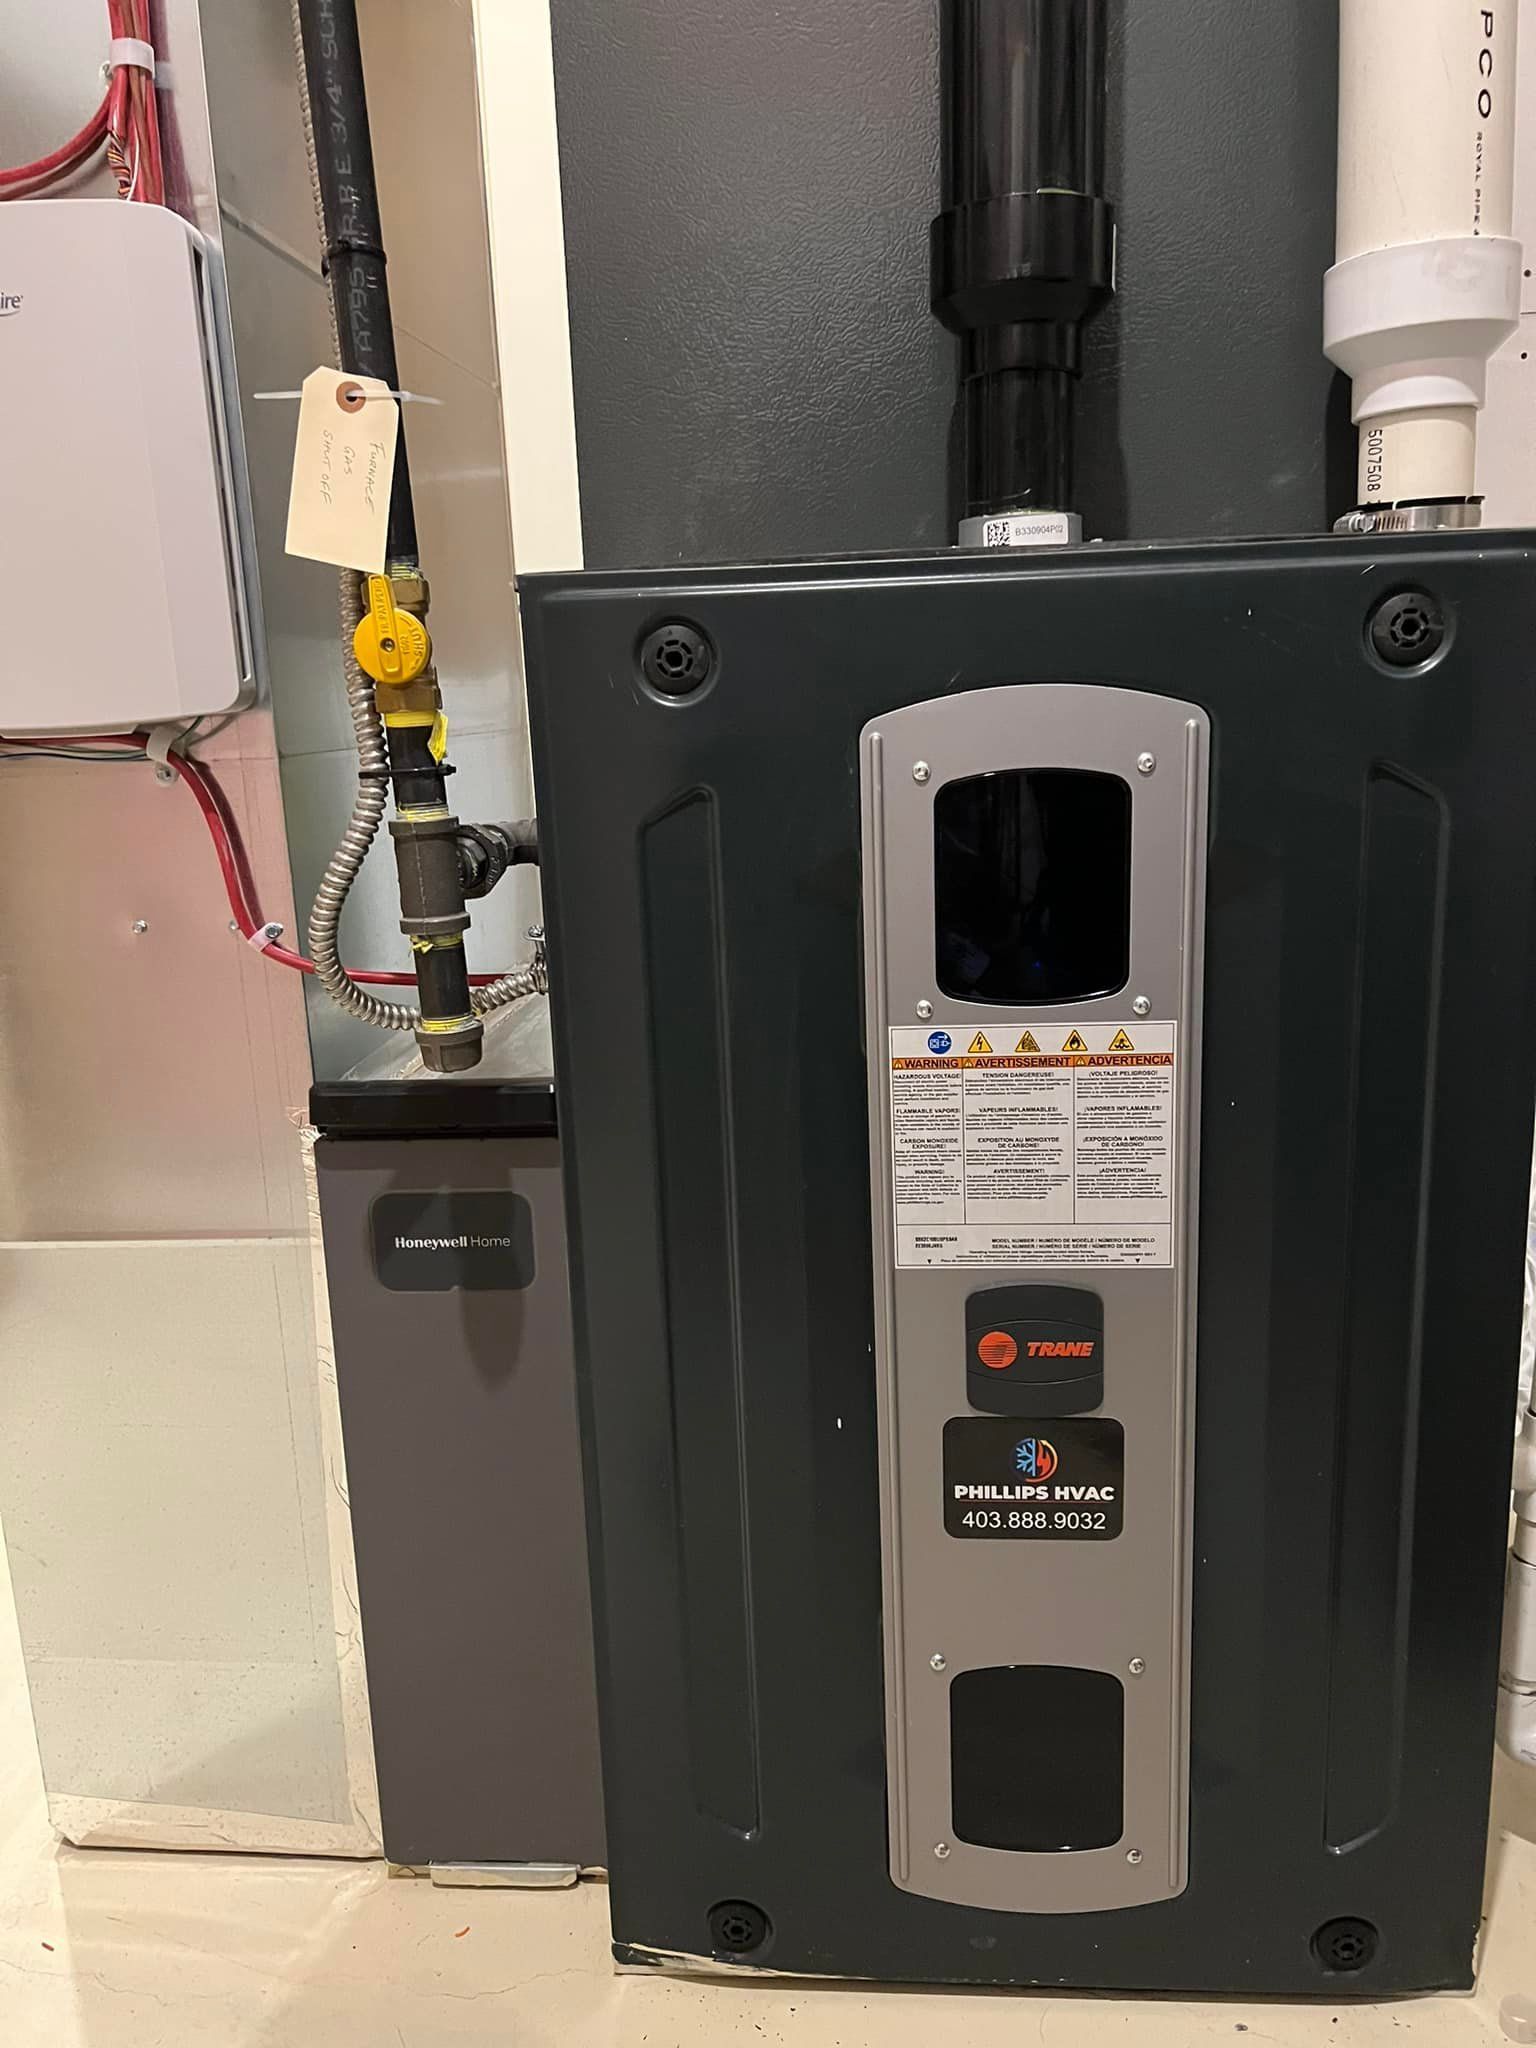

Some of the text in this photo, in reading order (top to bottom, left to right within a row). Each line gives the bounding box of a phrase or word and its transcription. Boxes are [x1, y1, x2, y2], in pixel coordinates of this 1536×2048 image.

[1367, 428, 1383, 492] 5007508
[904, 1058, 959, 1069] WARNING
[974, 1057, 1072, 1068] AVERTISSEMENT
[1087, 1055, 1172, 1066] ADVERTENCIA
[395, 1236, 511, 1250] Honeywell Home
[1027, 1341, 1095, 1358] TRANE
[954, 1485, 1115, 1501] PHILLIPS HVAC
[962, 1511, 1106, 1530] 403.888.9032
